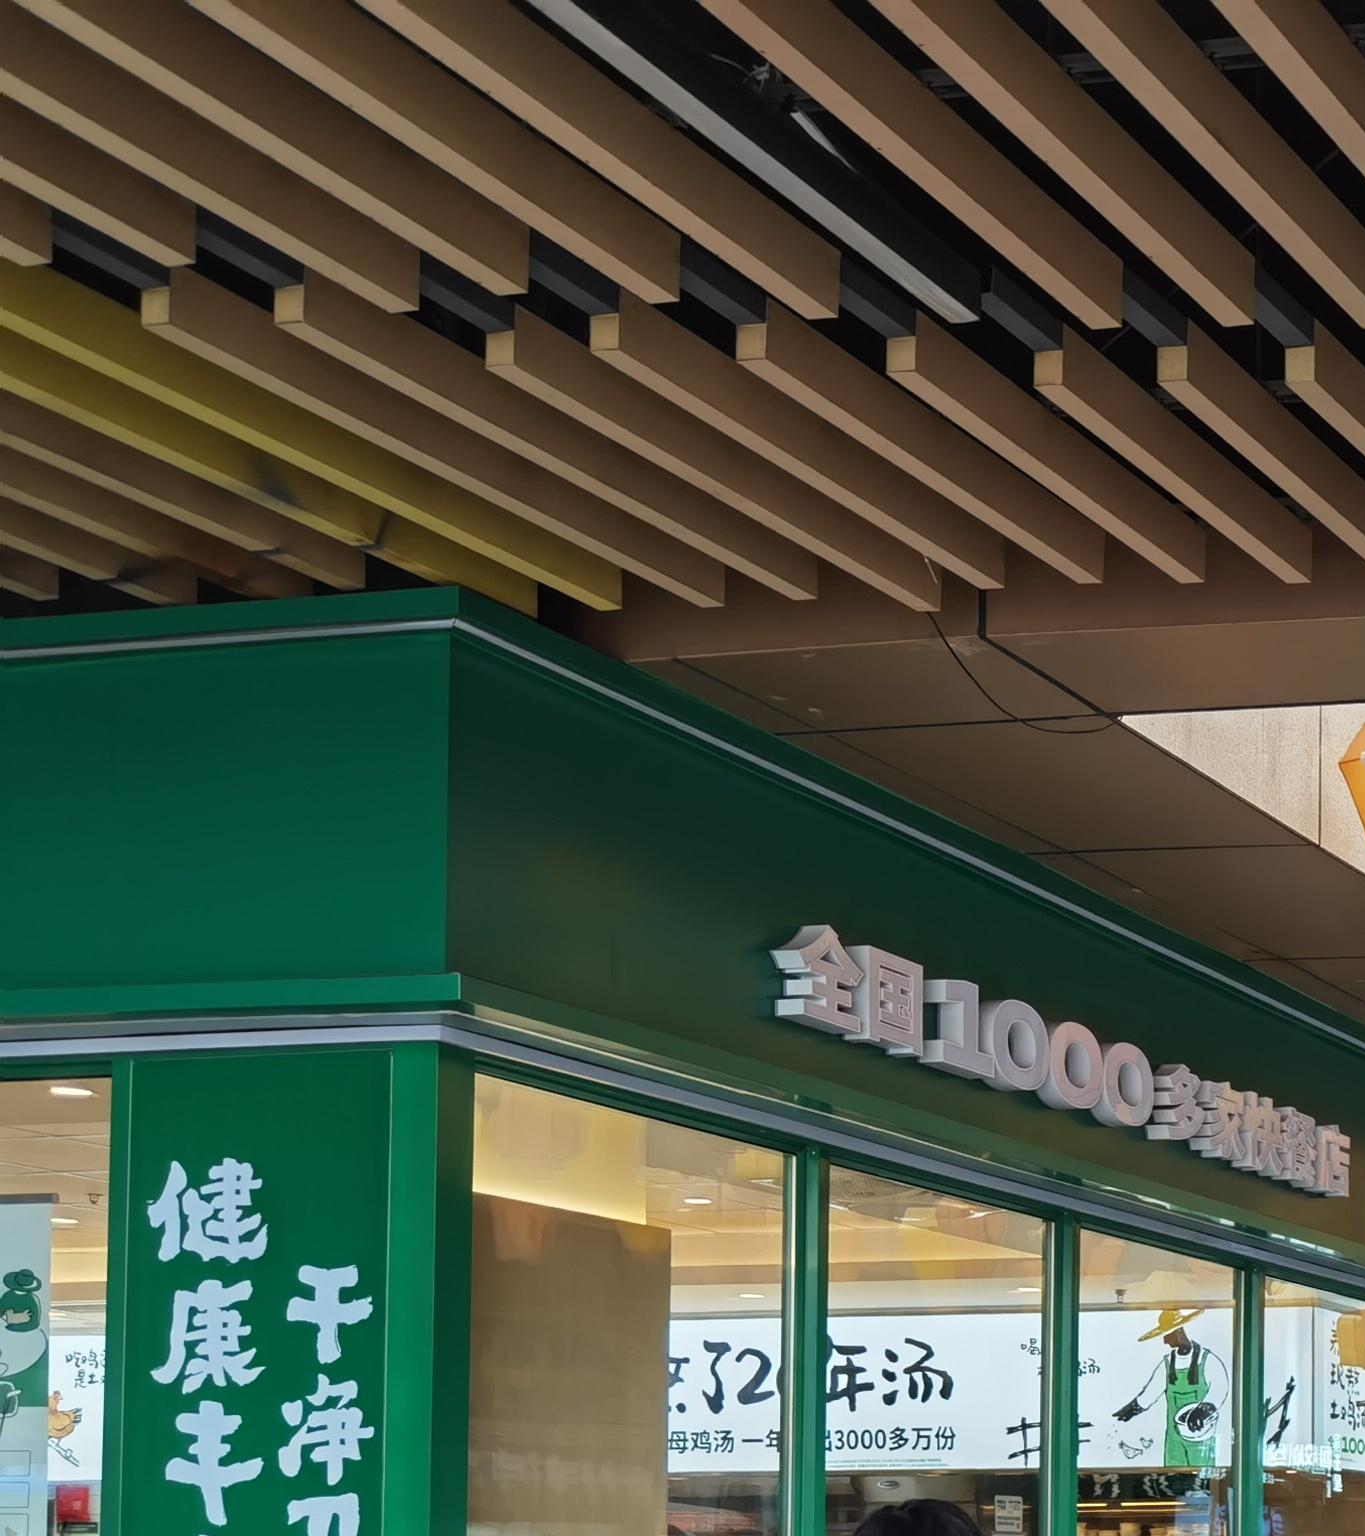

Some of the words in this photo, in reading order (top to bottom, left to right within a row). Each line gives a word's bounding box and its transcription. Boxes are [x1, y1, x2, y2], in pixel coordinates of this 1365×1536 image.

[770, 924, 1351, 1197] 全国1000多家快餐店
